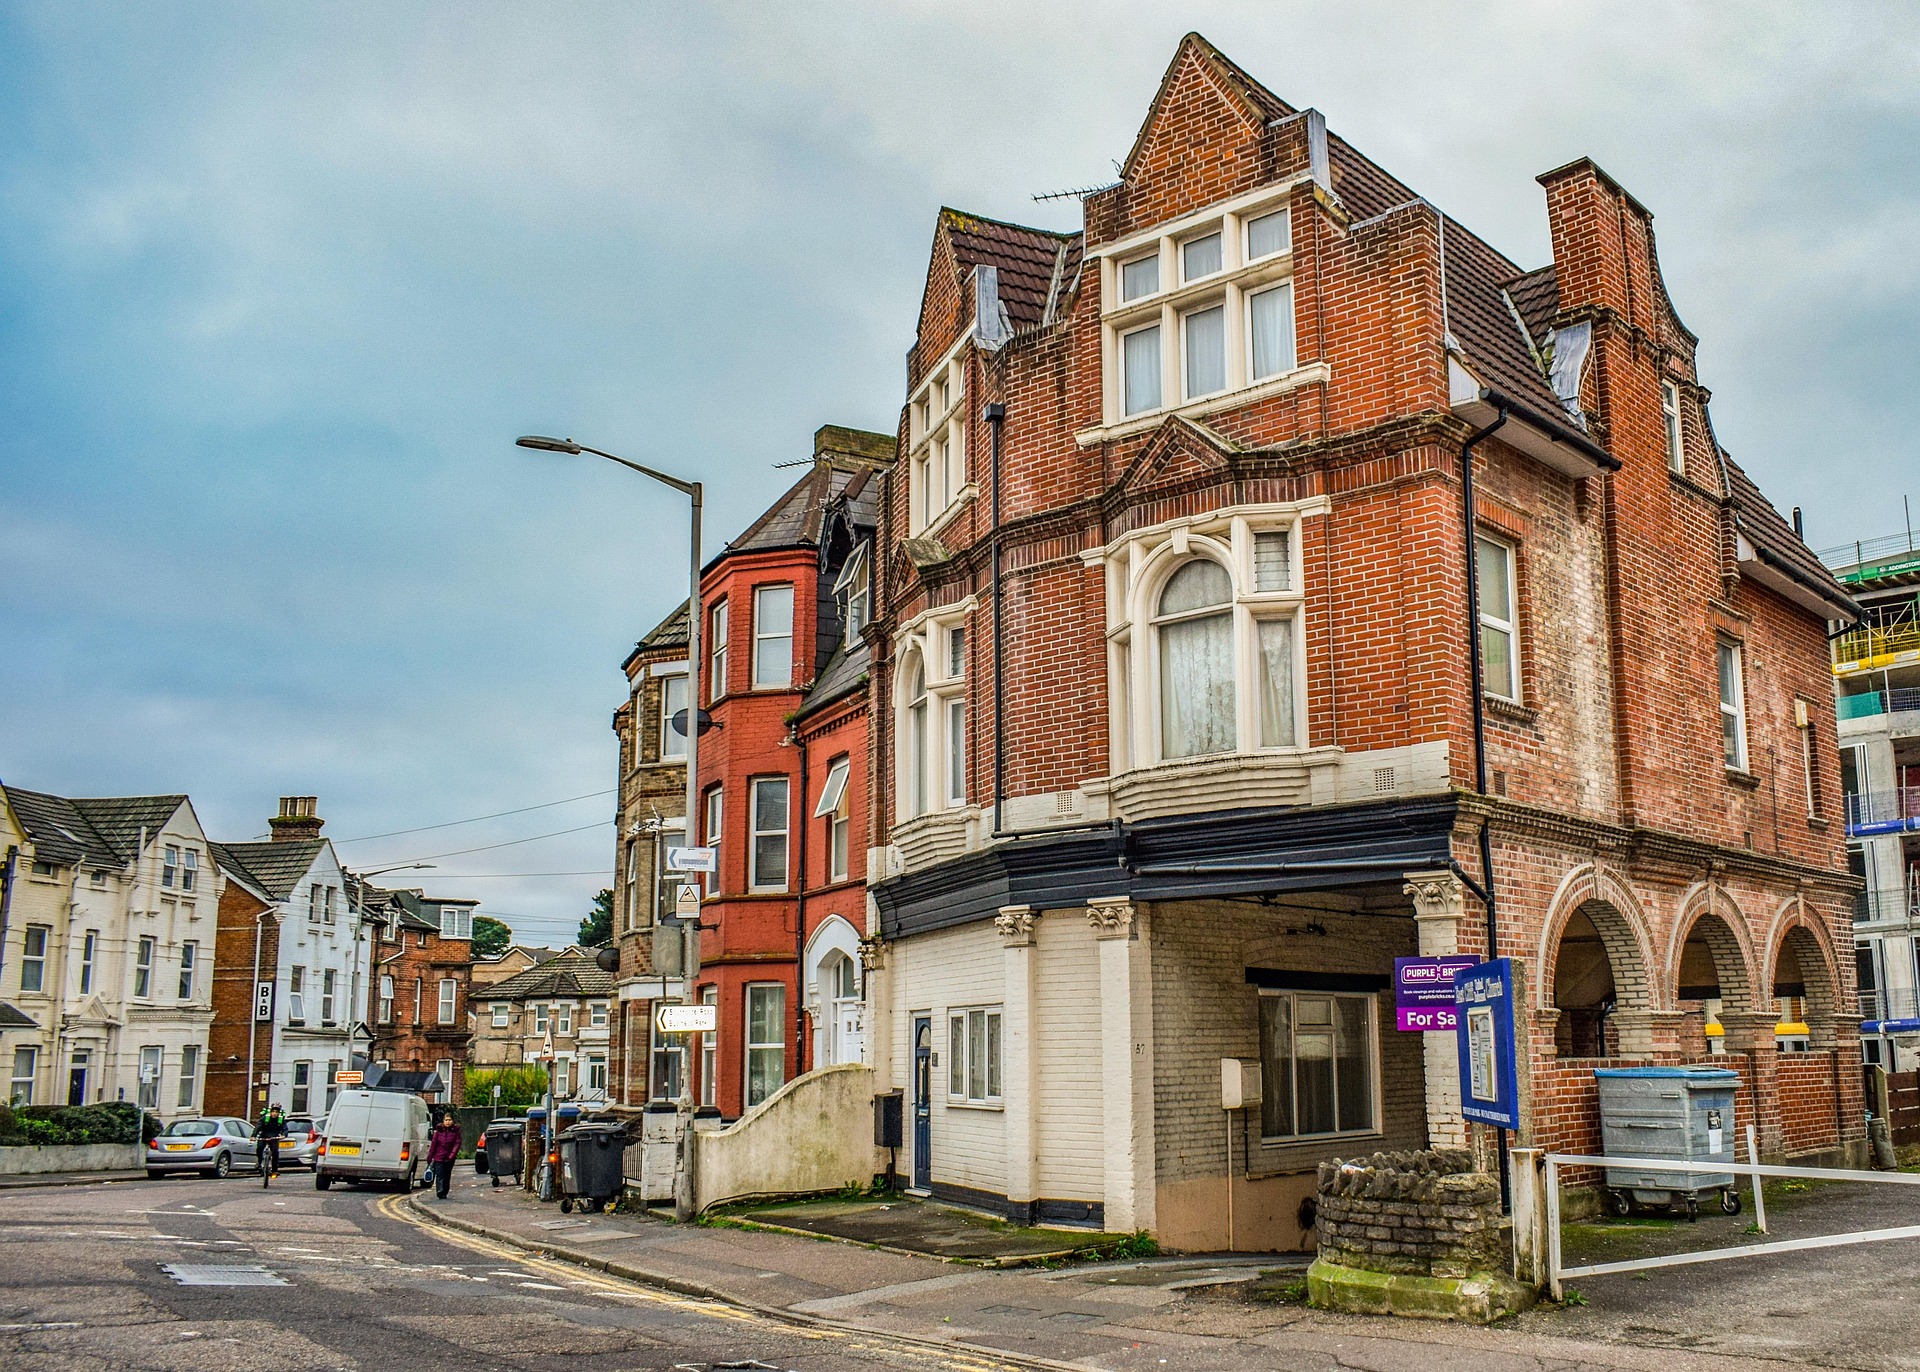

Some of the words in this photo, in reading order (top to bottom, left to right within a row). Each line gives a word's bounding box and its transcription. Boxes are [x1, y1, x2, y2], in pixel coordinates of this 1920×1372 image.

[1406, 968, 1436, 978] PURPLE
[261, 986, 269, 997] B
[260, 1005, 268, 1016] B
[1406, 1012, 1433, 1026] For
[1437, 1011, 1456, 1026] Sa
